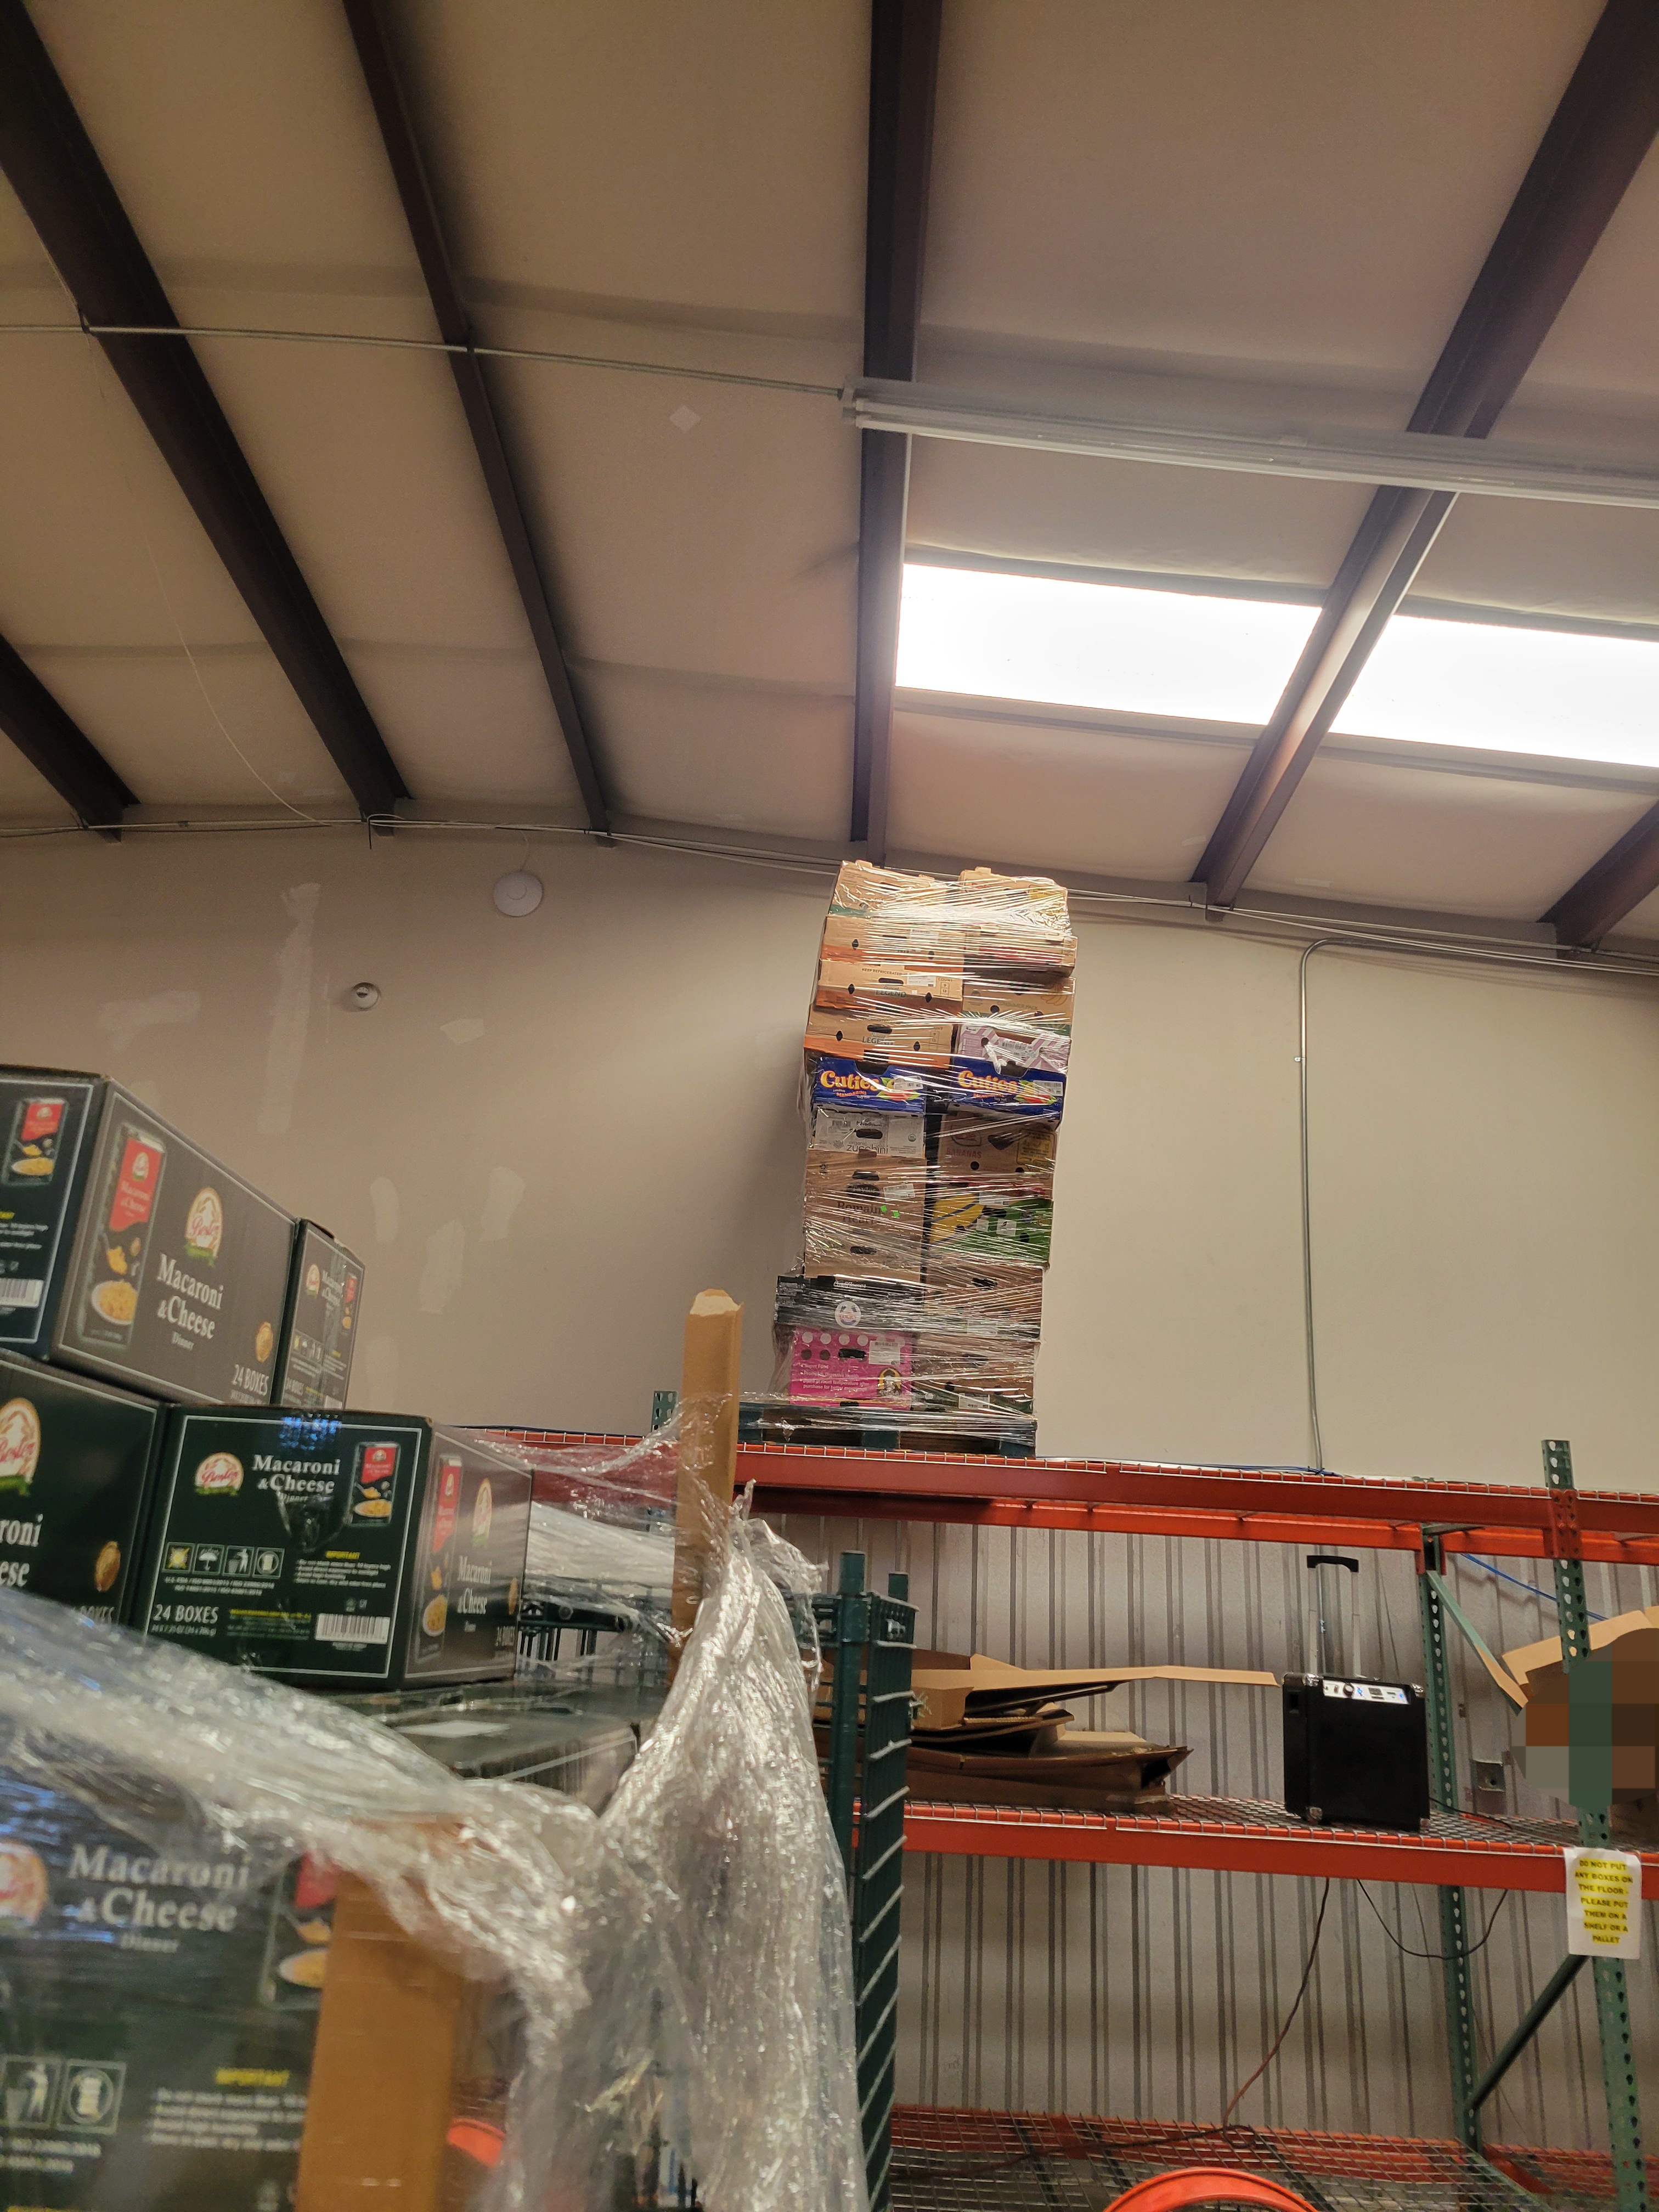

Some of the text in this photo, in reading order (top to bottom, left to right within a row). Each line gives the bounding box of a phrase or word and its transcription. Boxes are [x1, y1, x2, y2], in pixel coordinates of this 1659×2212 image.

[997, 1001, 1025, 1009] CONSUMER
[820, 1070, 880, 1092] Cuties
[958, 1070, 1018, 1093] Cuties
[847, 1144, 889, 1154] zucchini
[946, 1148, 982, 1159] BANANAS
[157, 1252, 224, 1310] Macaroni
[232, 1364, 269, 1396] 24 BOXES
[252, 1454, 341, 1475] Macaroni
[457, 1555, 492, 1585] Macaroni
[153, 1604, 219, 1624] 24 BOXES
[68, 1843, 252, 1890] Macaroni
[1591, 1861, 1607, 1869] NOT
[1611, 1863, 1627, 1871] PUT
[1592, 1873, 1620, 1882] BOXES
[1579, 1884, 1594, 1892] THE
[1598, 1885, 1623, 1895] FLOOR
[1581, 1897, 1610, 1907] PLEASE
[1584, 1910, 1607, 1918] THEM
[1584, 1922, 1607, 1930] SHELF
[1593, 1935, 1620, 1944] PALLET
